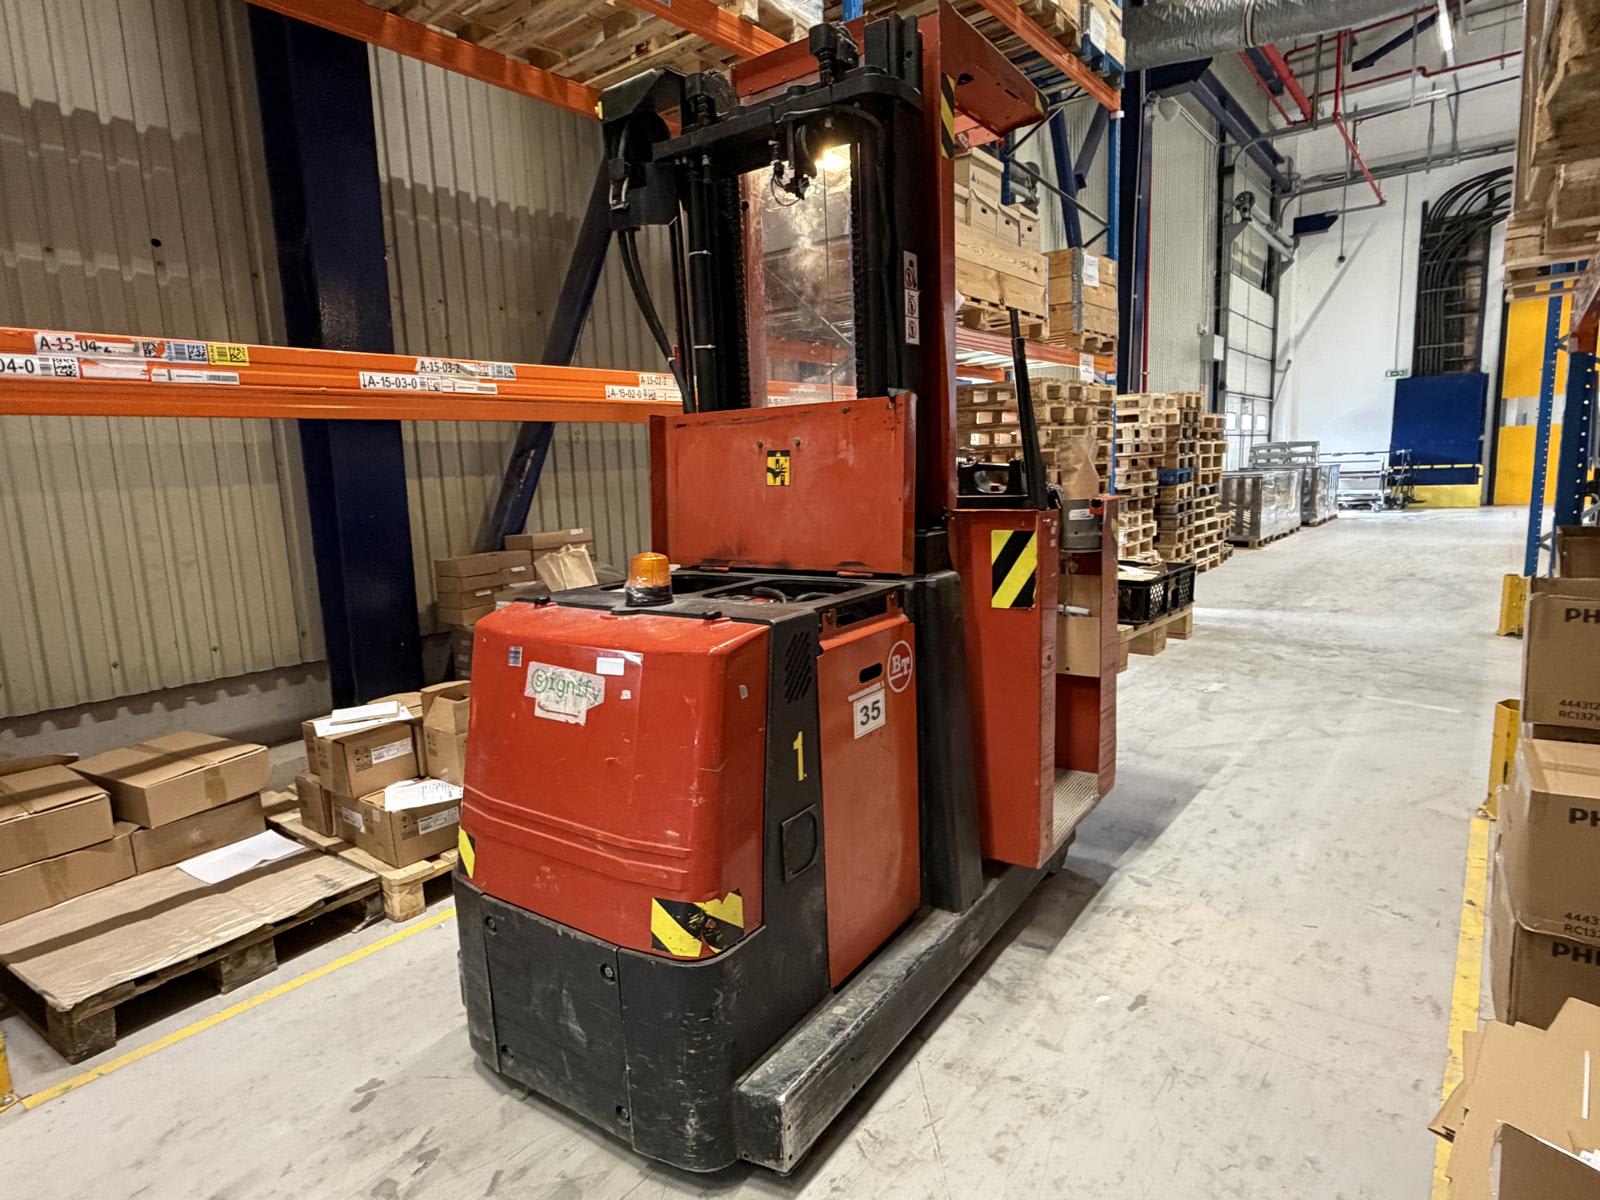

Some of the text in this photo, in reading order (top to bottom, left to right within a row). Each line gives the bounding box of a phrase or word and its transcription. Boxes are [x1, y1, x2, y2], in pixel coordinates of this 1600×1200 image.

[420, 360, 460, 374] A-15-03-2
[368, 376, 418, 389] A-15-03-0
[611, 387, 642, 399] A-15-02-0
[860, 699, 881, 726] 35
[793, 731, 805, 782] 1
